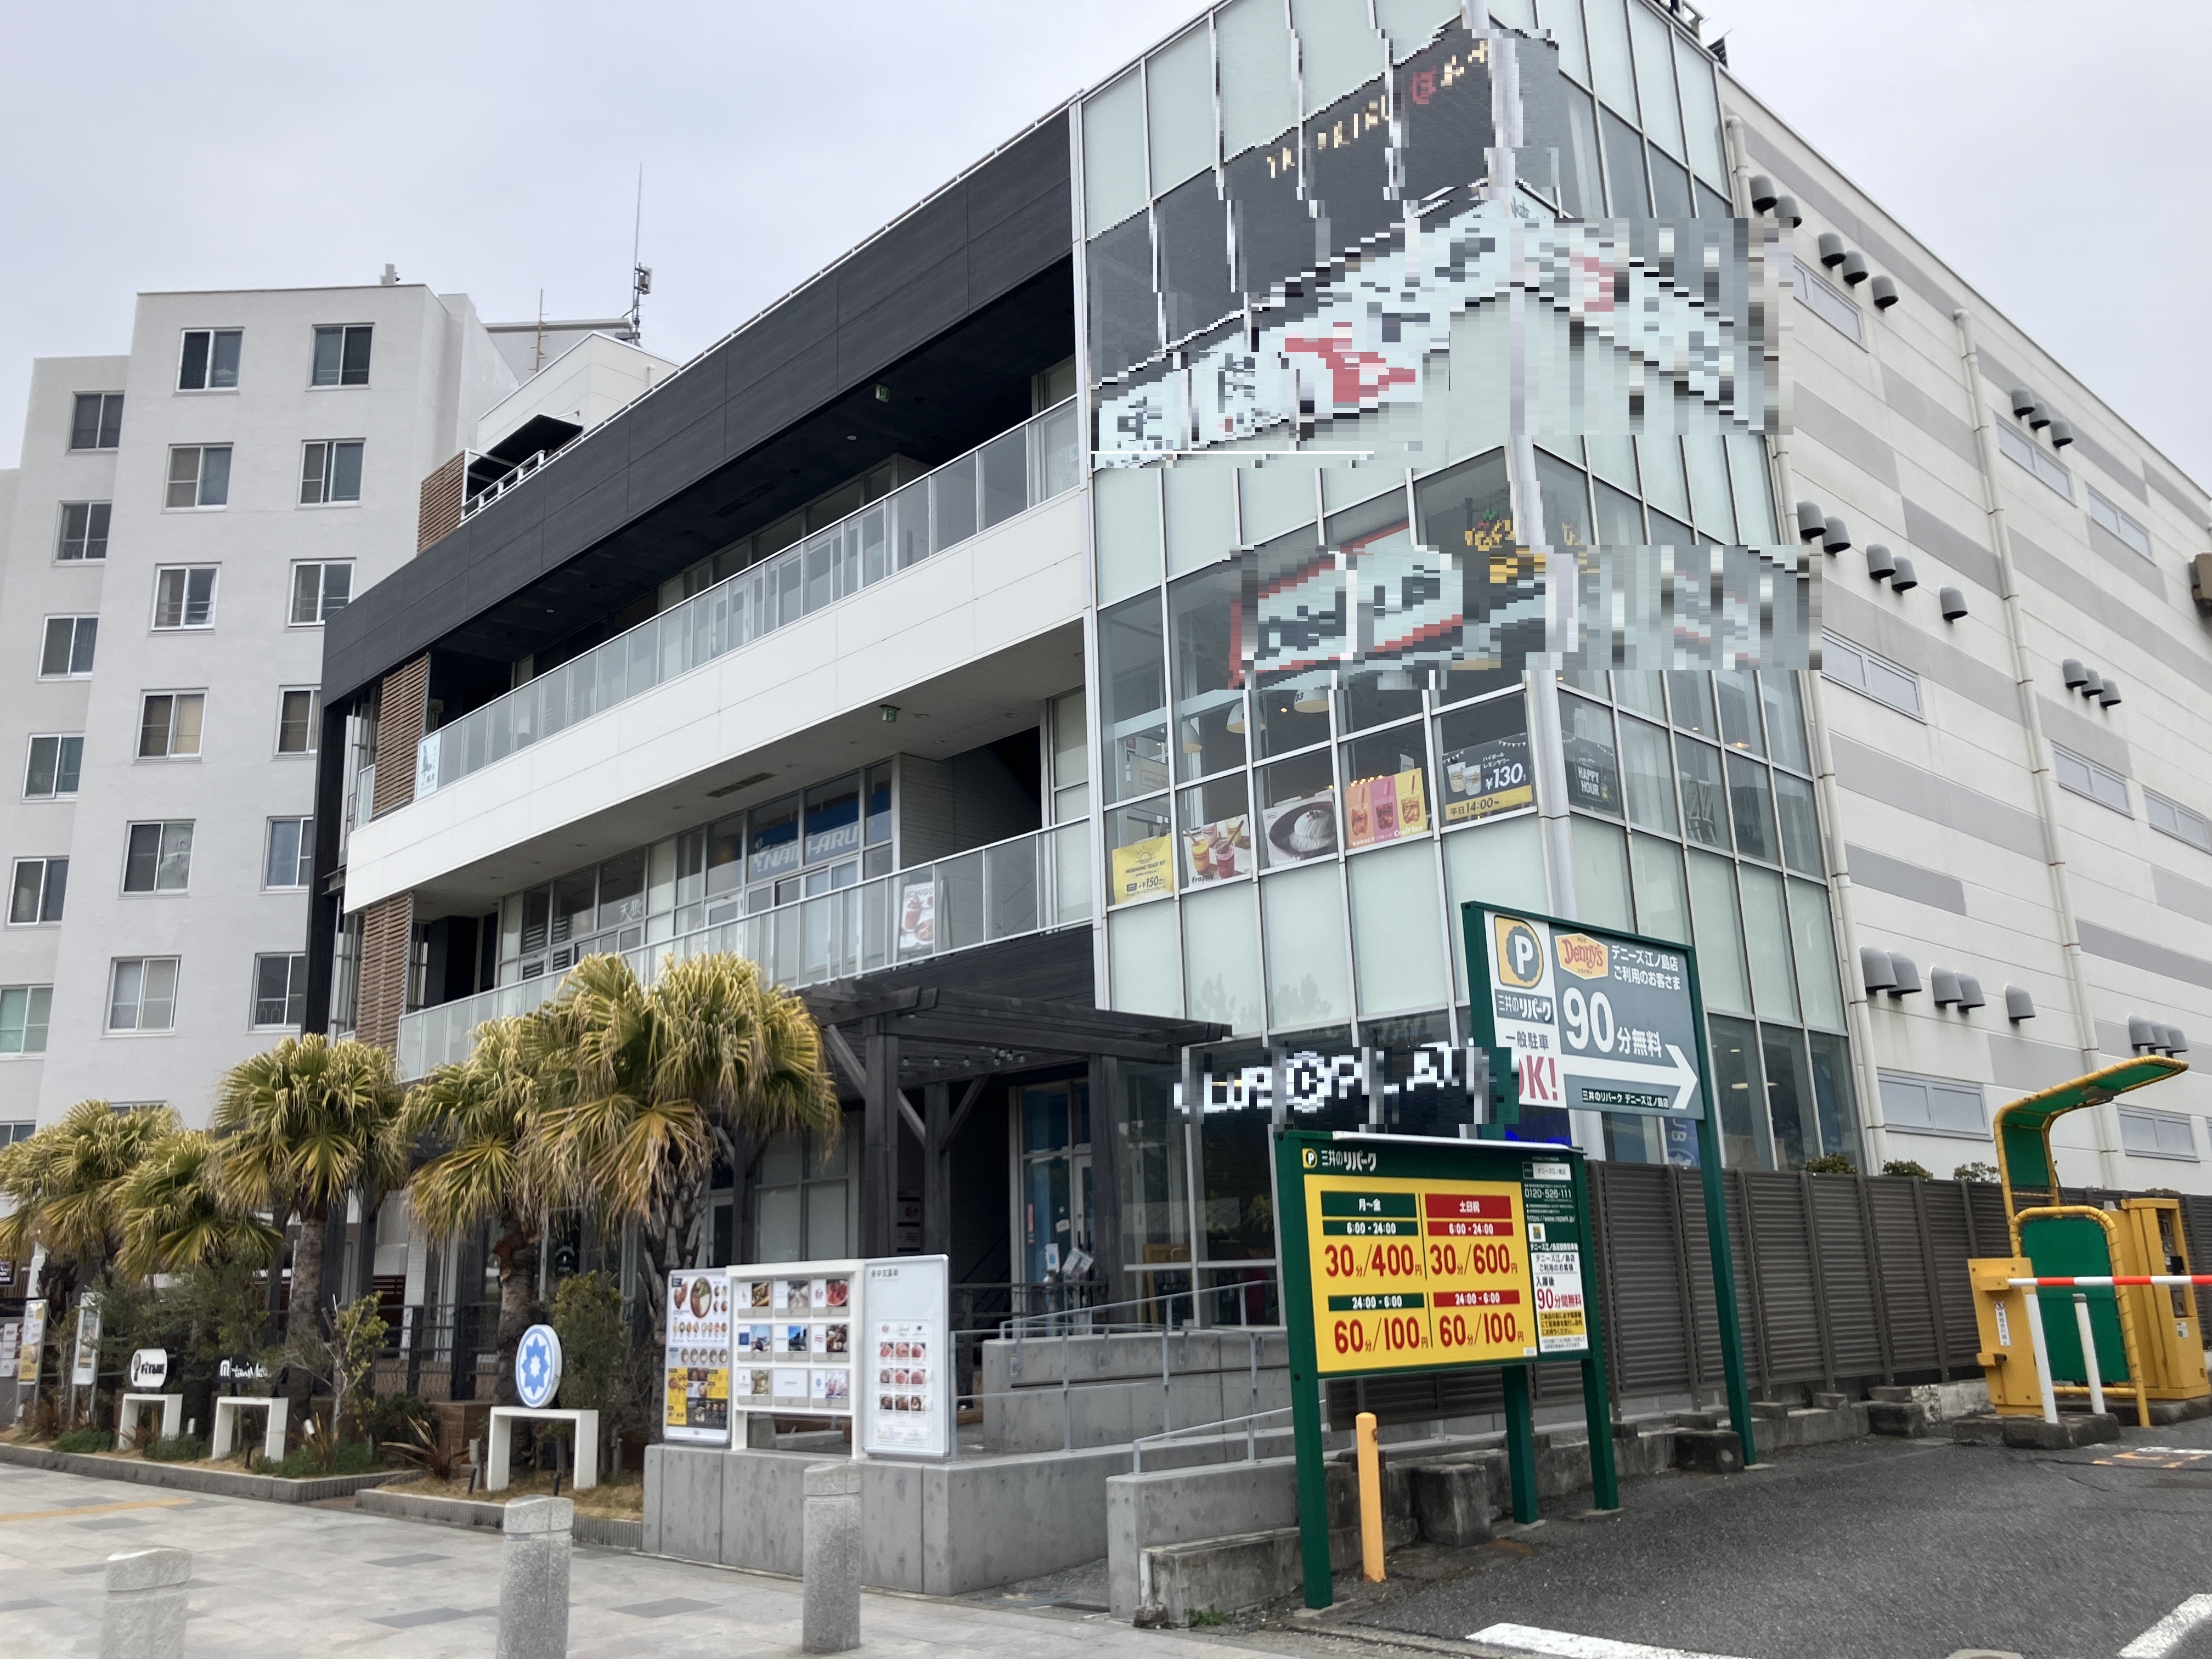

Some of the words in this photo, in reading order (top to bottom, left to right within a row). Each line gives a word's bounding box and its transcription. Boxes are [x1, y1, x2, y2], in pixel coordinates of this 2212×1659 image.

[1483, 752, 1505, 761] ハイボール
[1483, 758, 1510, 769] レモンサワー
[1485, 763, 1523, 790] ¥130
[1578, 766, 1599, 783] HAPPY
[1581, 779, 1599, 797] HOUR
[1394, 827, 1410, 837] Craft
[1125, 865, 1146, 874] MORNING
[1274, 856, 1301, 866] Pancake
[1192, 874, 1214, 883] Frappy
[1514, 935, 1533, 975] P
[1561, 939, 1603, 969] Denny's
[1611, 945, 1678, 972] デニーズ江ノ島店
[1614, 965, 1680, 990] ご利用のお客さま
[1498, 995, 1551, 1022] 三井のリパーク
[1505, 1030, 1549, 1051] 一般駐車
[1322, 1149, 1376, 1172] 三井のリパーク
[1459, 1200, 1480, 1214] 土日祝
